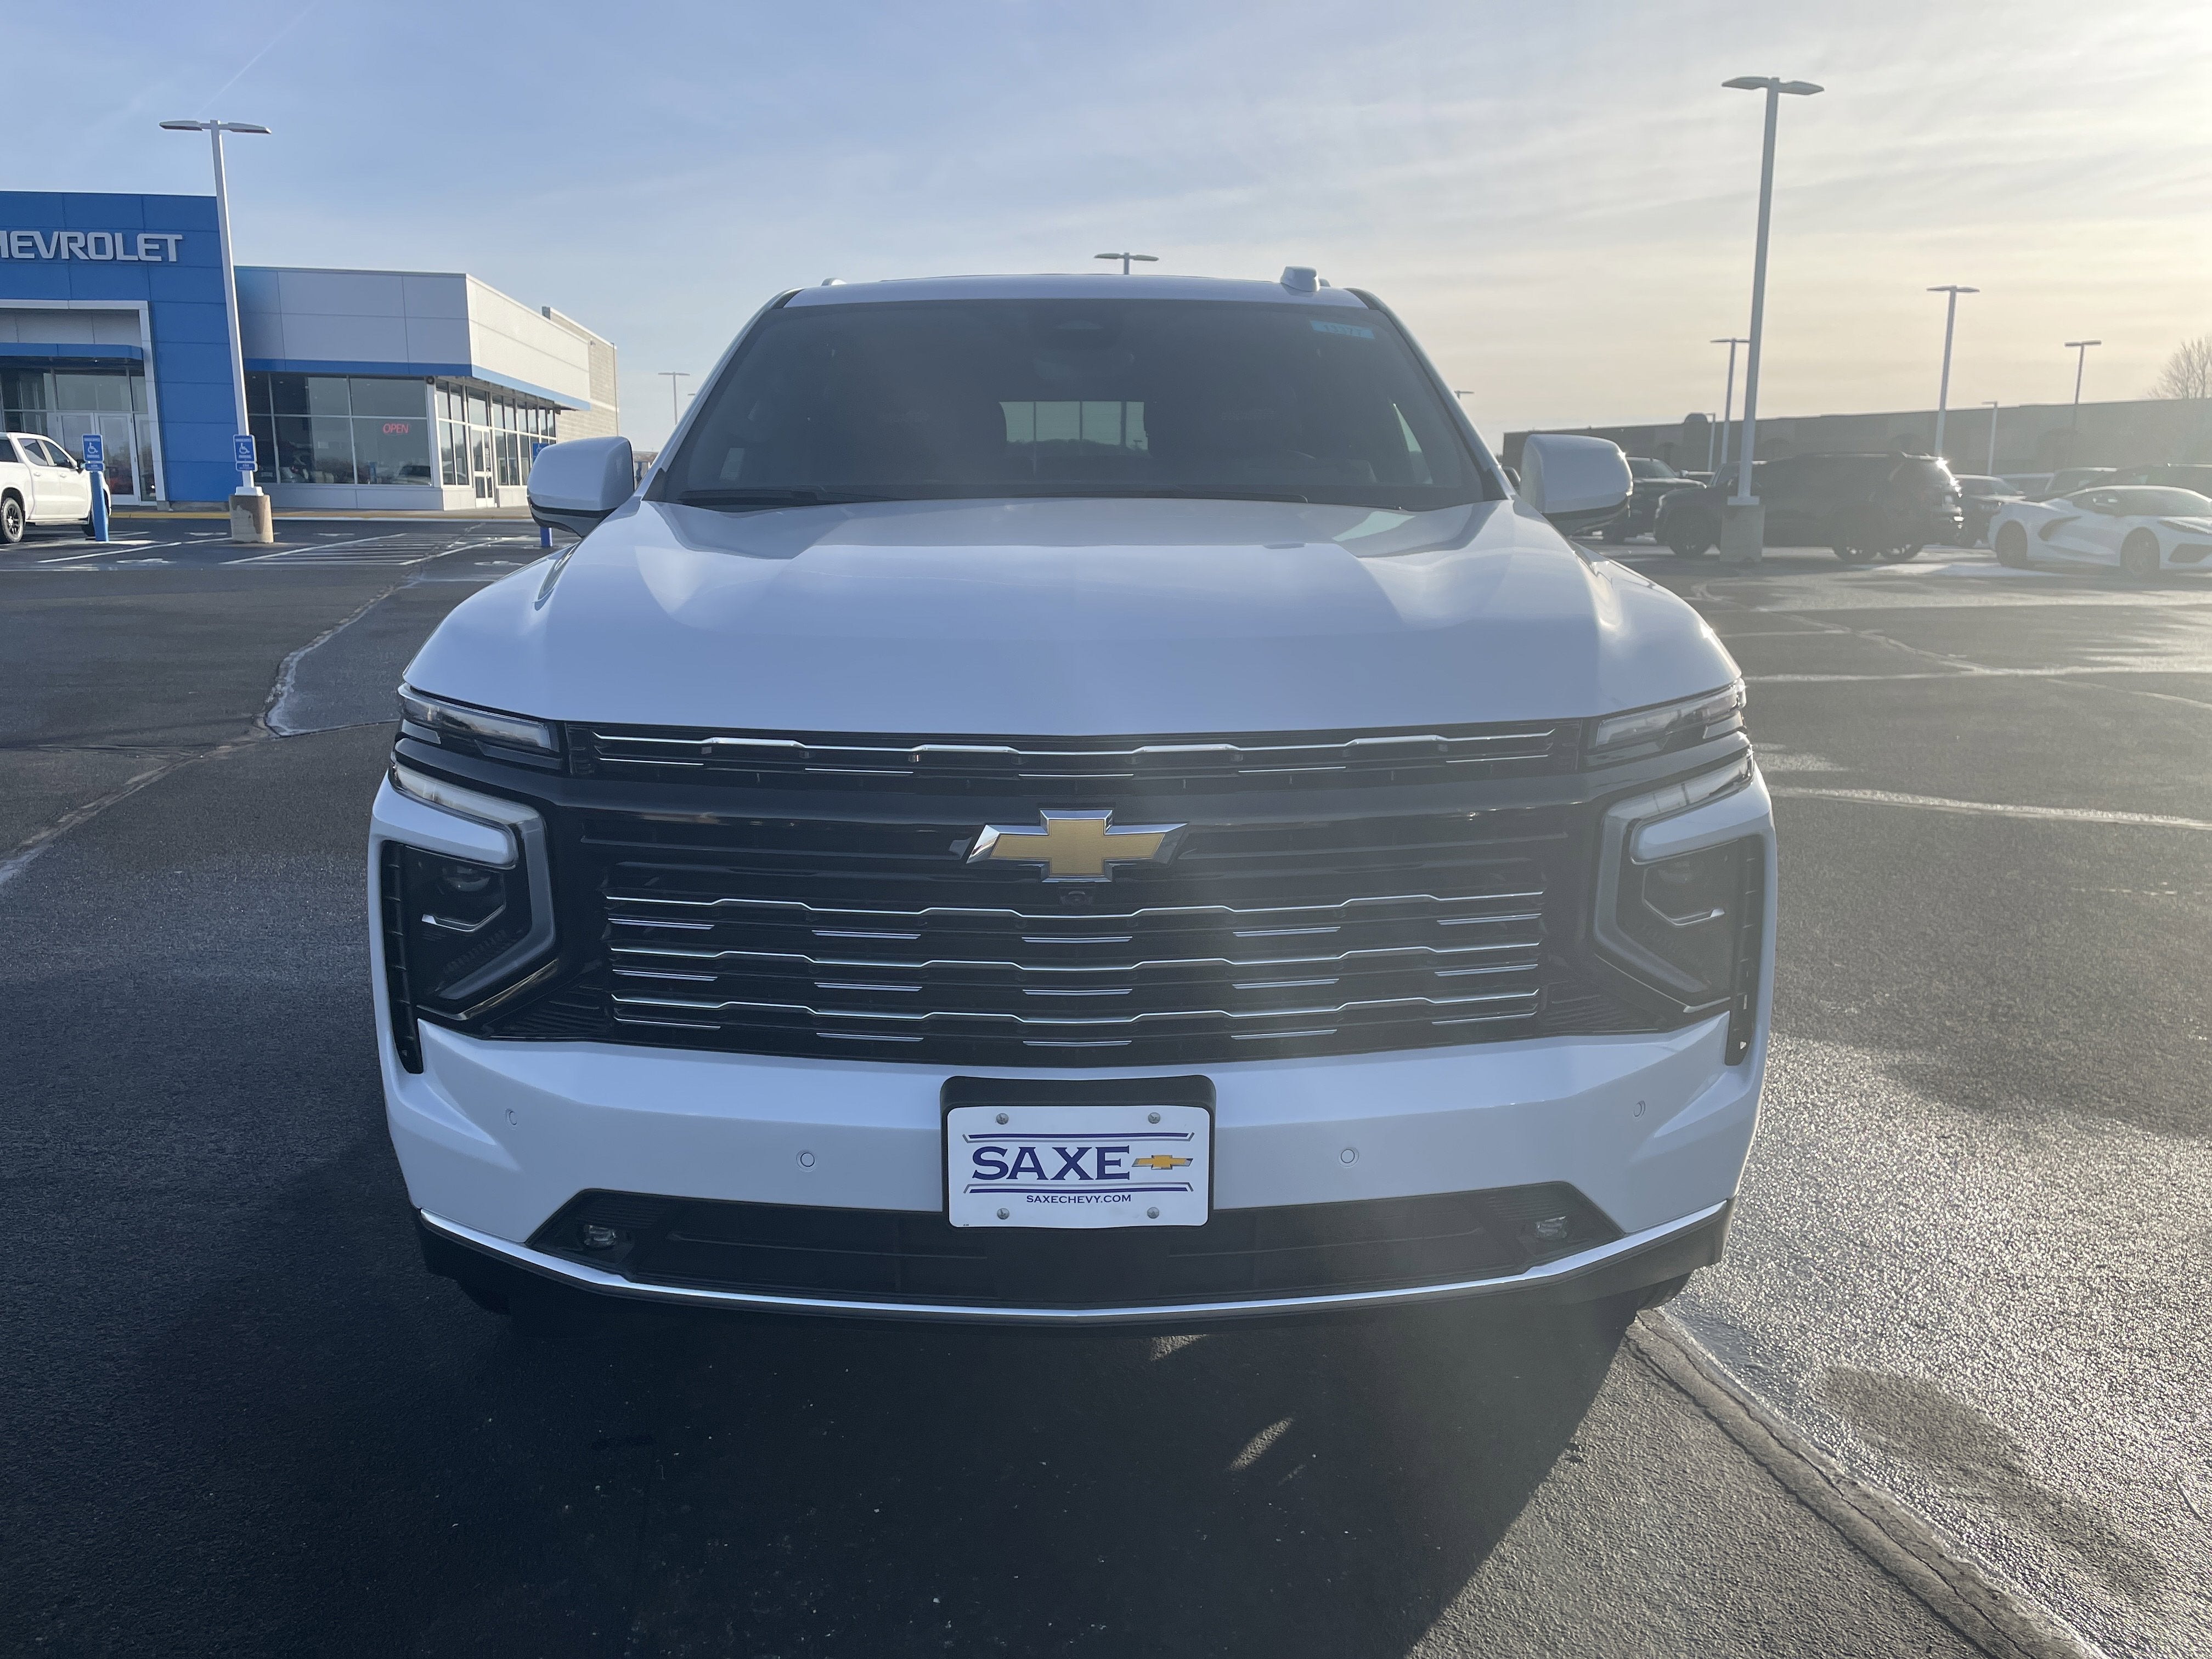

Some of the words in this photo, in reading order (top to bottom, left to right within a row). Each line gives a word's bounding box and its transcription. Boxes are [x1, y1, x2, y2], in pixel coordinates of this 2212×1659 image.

[382, 423, 409, 435] OPEN
[972, 1145, 1130, 1180] SAXE
[1026, 1194, 1131, 1204] SAXECHEVY.COM
